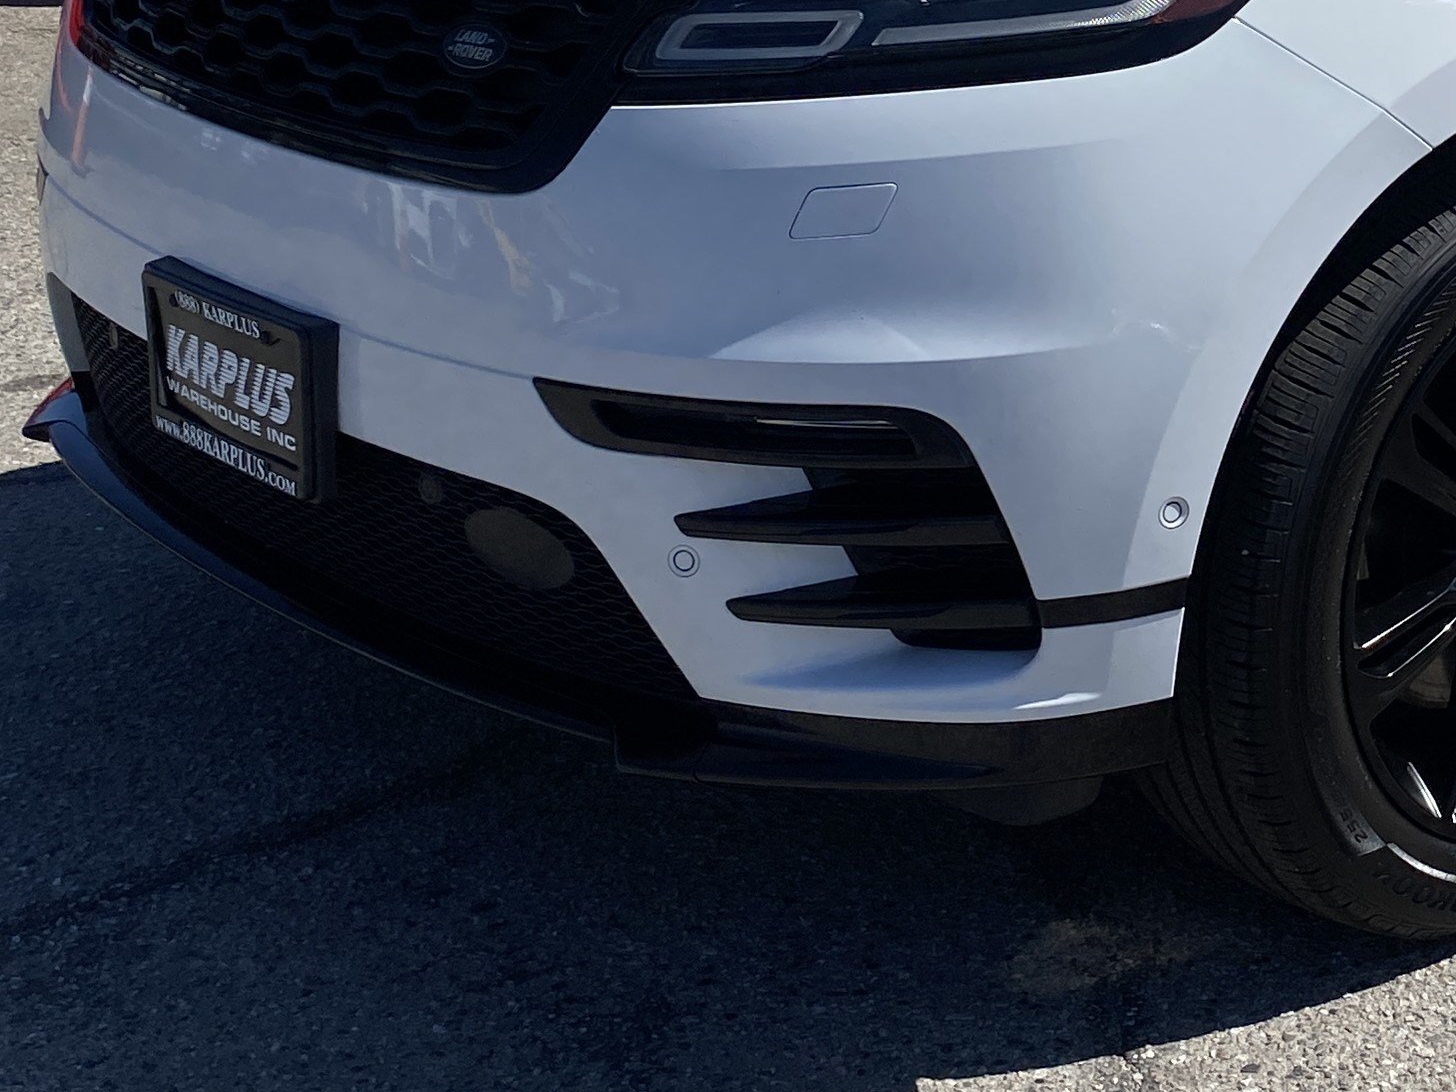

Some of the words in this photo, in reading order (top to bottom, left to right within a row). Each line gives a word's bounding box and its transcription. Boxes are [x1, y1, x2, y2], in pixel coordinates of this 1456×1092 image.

[452, 43, 493, 62] ROVER
[454, 30, 488, 45] LAND
[201, 301, 261, 340] KARPLUS
[166, 323, 296, 426] KARPLUS
[166, 375, 262, 437] WAREHOUSE
[267, 426, 297, 452] INC
